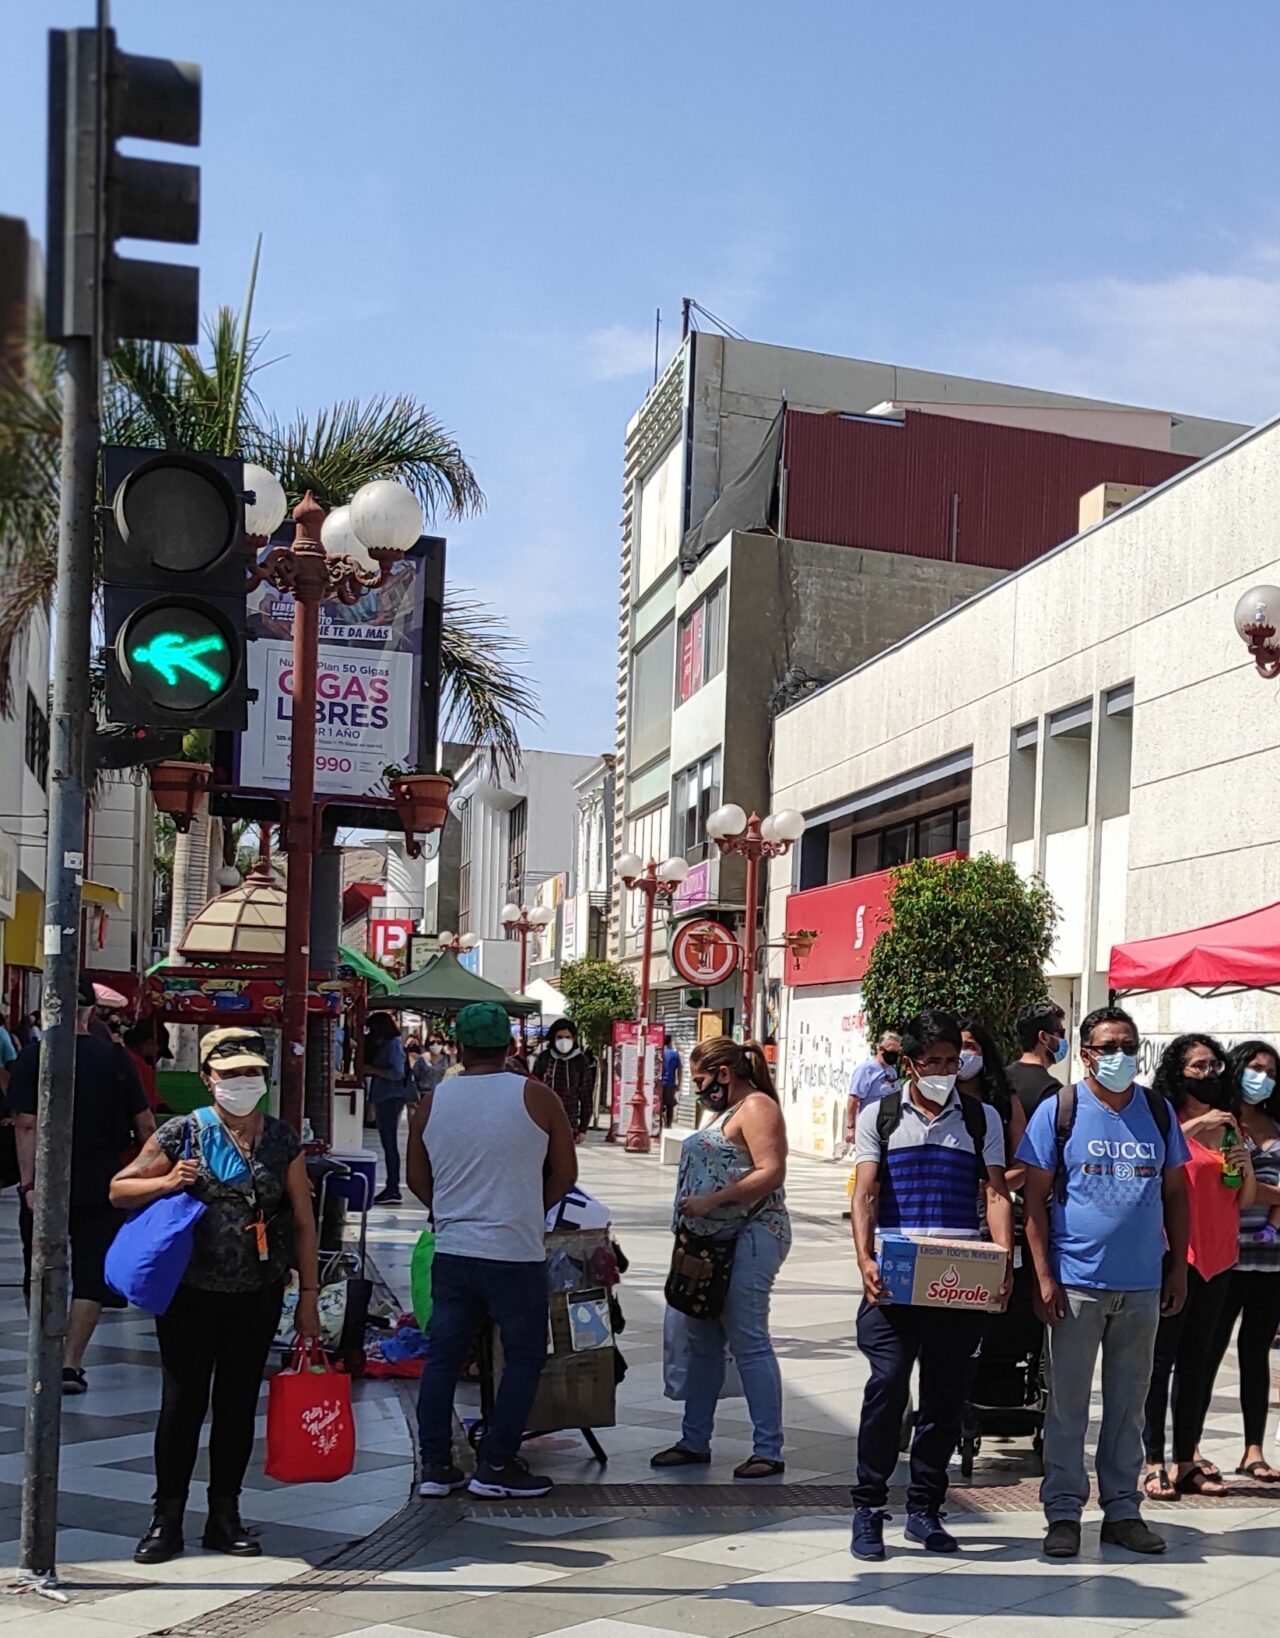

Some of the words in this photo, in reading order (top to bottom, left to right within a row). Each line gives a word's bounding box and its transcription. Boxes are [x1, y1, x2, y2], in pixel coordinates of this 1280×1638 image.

[333, 626, 345, 637] TE
[347, 627, 362, 638] DA
[342, 664, 357, 674] 50
[360, 666, 390, 678] Gigas
[278, 669, 389, 704] GGAS
[276, 696, 389, 730] LBRES
[328, 728, 333, 737] 1
[335, 728, 361, 739] AÑO
[1087, 1139, 1157, 1160] GUCCI
[928, 1281, 990, 1305] Soprole
